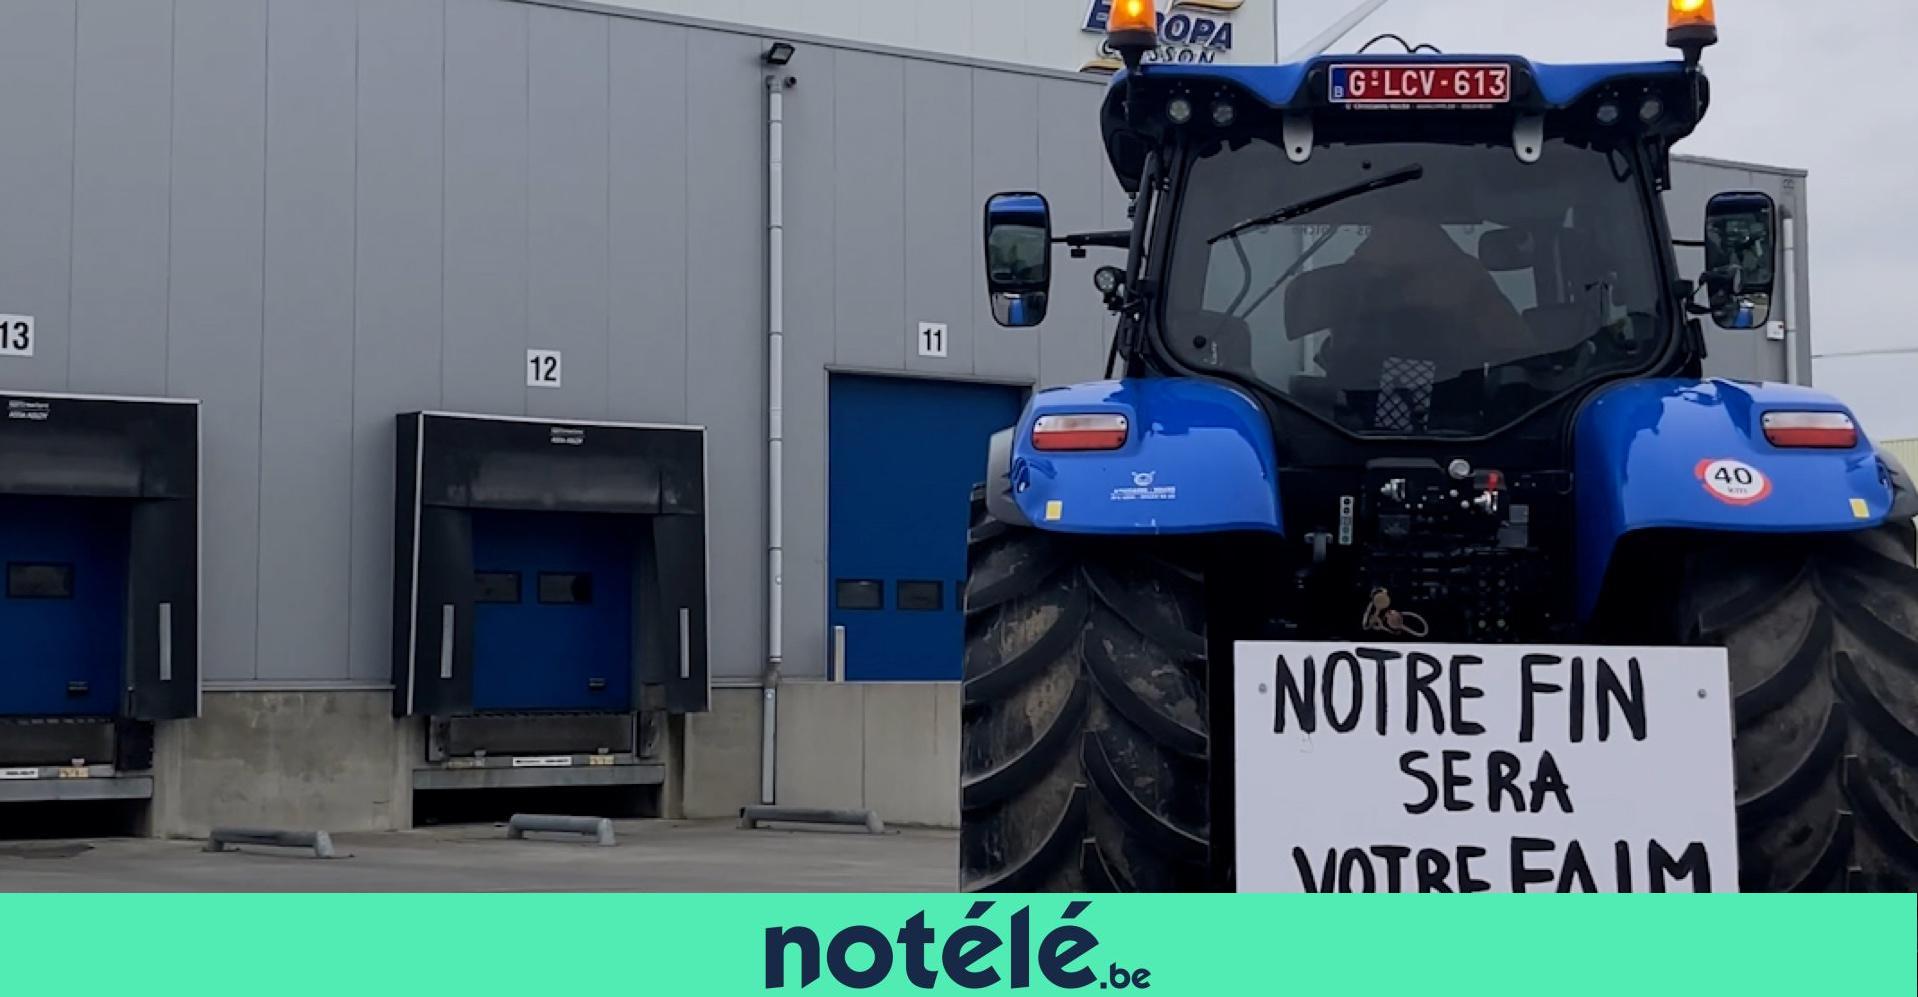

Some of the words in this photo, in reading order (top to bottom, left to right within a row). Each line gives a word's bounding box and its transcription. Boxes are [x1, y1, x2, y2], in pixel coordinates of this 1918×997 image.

[0, 321, 29, 350] 13
[923, 329, 941, 351] 11
[530, 356, 557, 381] 12
[1714, 467, 1752, 485] 40
[1274, 647, 1486, 736] NOTRE
[1519, 653, 1648, 743] FIN
[1399, 750, 1574, 815] SERA
